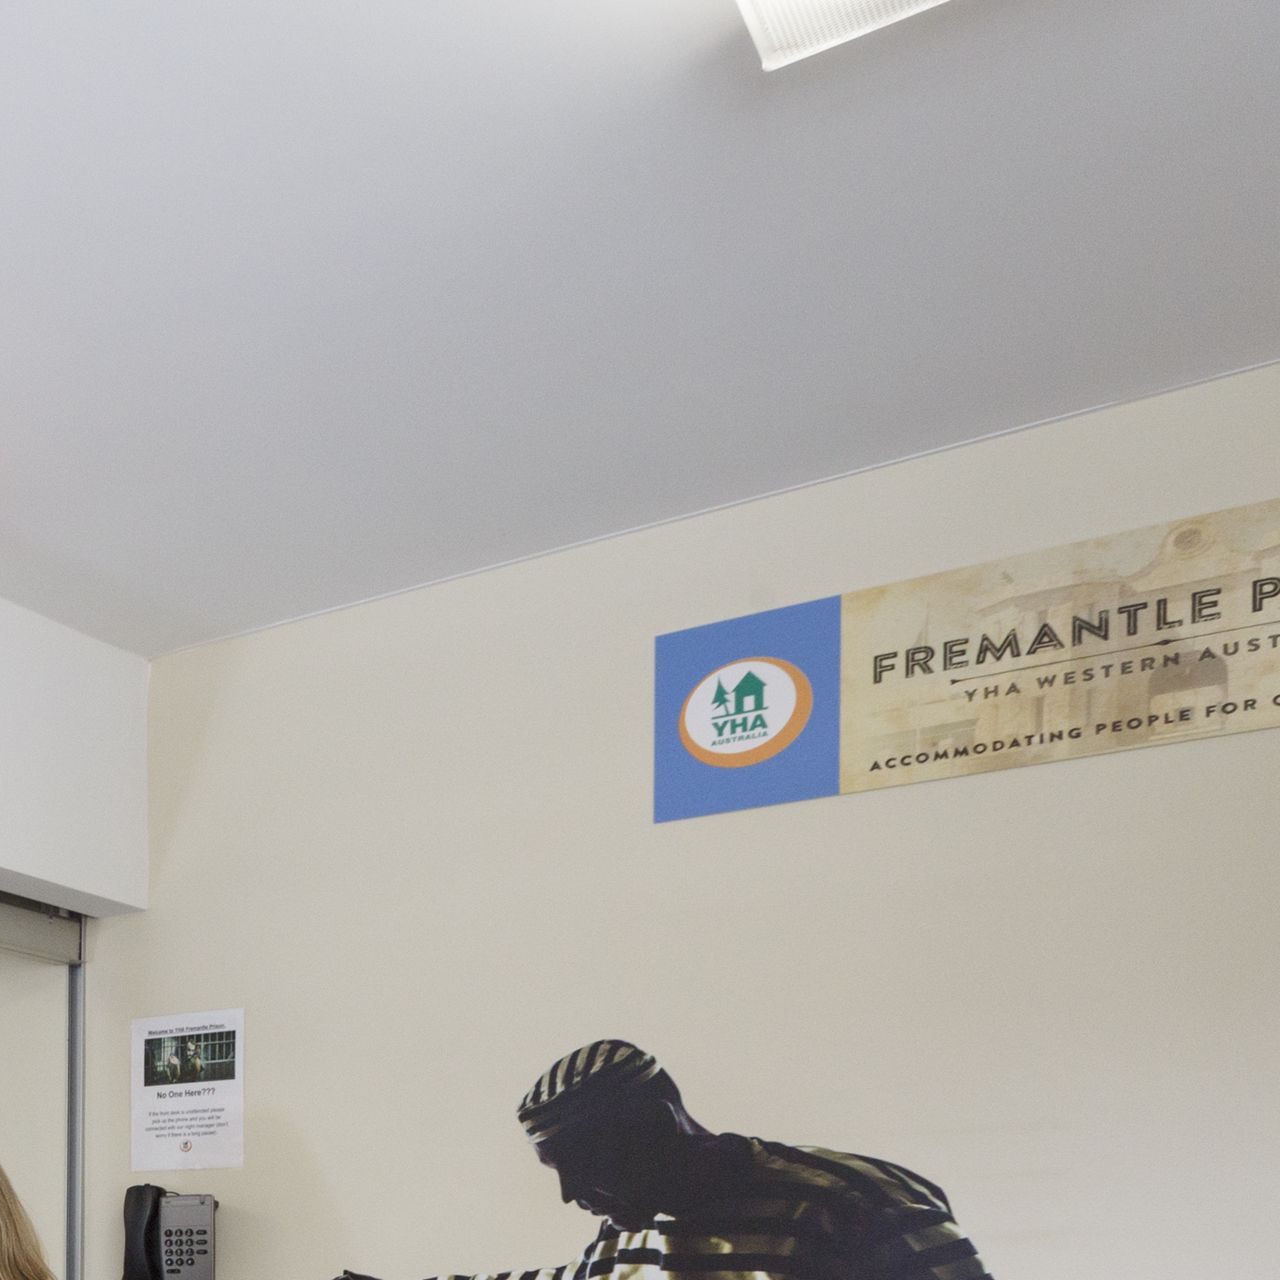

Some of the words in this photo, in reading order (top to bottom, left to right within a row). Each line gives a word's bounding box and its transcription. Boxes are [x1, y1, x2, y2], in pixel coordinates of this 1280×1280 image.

[873, 588, 1222, 685] FREMANTLE
[964, 682, 1020, 702] YHA
[1036, 652, 1180, 689] WESTERN
[711, 731, 768, 746] AUSTRALIA
[712, 714, 768, 737] YHA
[870, 727, 1082, 772] ACCOMMODATING
[1095, 708, 1191, 737] PEOPLE
[1205, 698, 1257, 717] FOR
[157, 1091, 166, 1099] No
[168, 1090, 183, 1098] One
[185, 1088, 215, 1096] Here???
